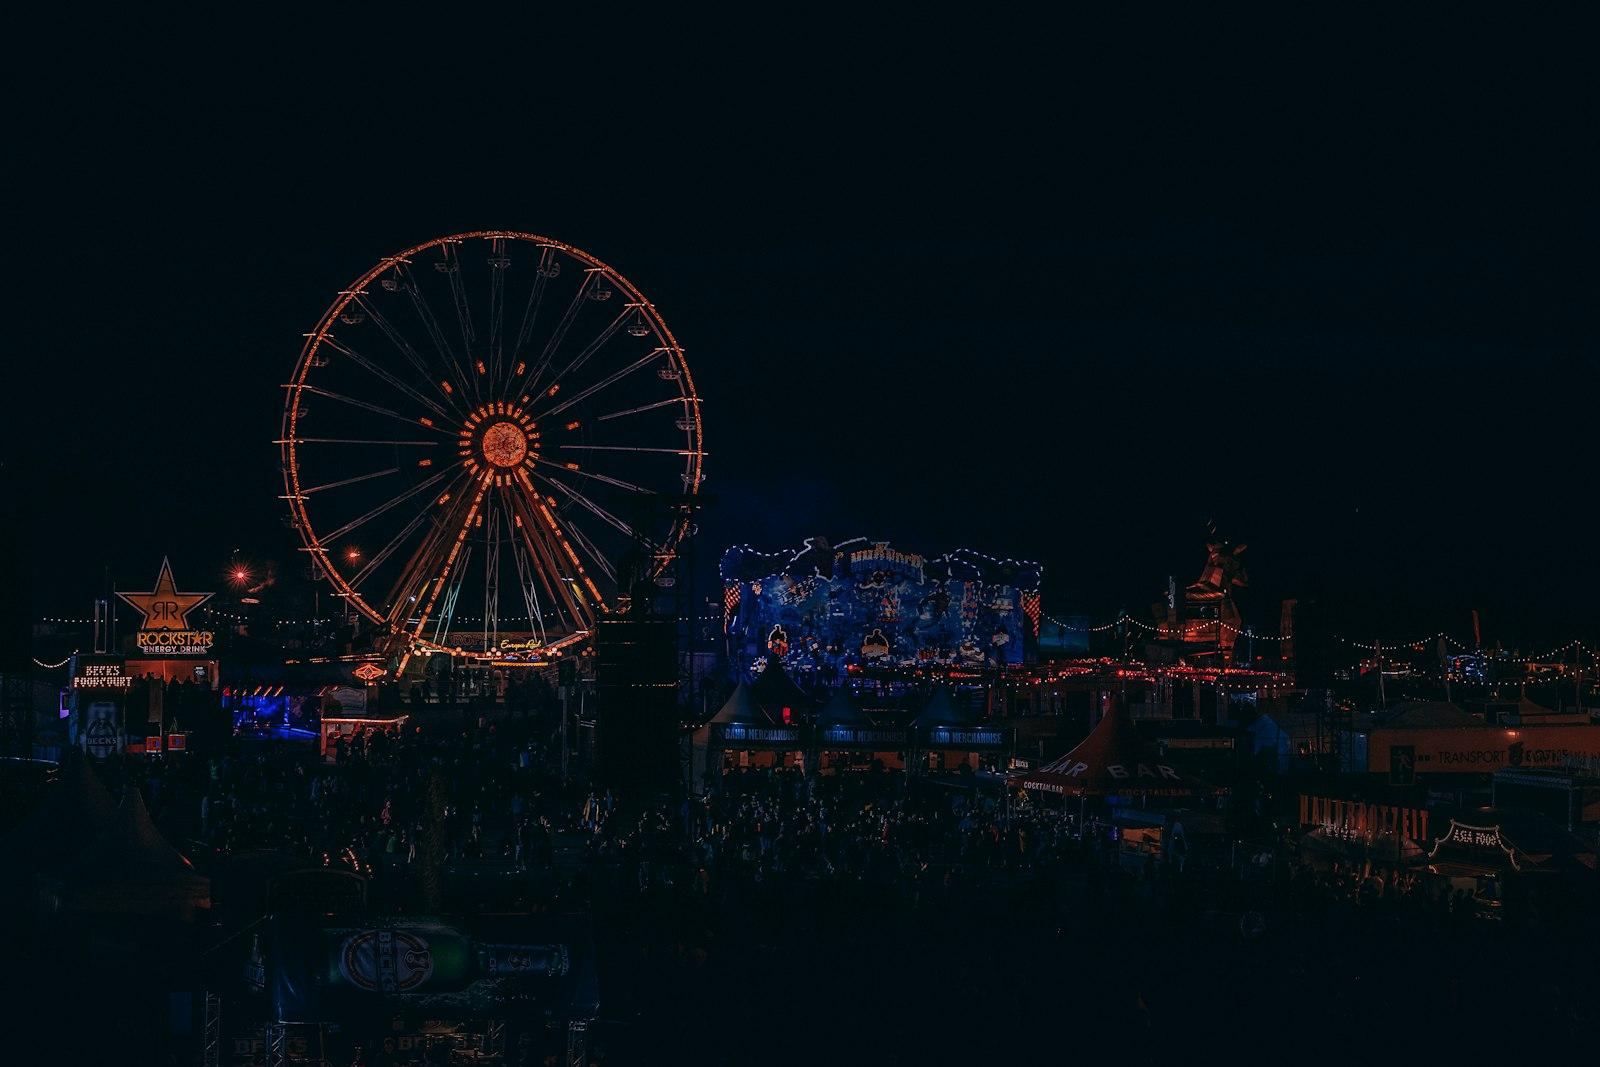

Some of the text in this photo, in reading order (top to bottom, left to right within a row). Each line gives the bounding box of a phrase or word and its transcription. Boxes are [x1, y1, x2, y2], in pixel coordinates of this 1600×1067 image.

[143, 645, 206, 654] ENERGY DRINK
[73, 677, 133, 688] FOODCOURT
[725, 729, 800, 742] BAND MERCHANDISE
[952, 731, 1002, 744] MERCHANDISE
[1438, 750, 1506, 764] TRANSPORT
[1106, 763, 1184, 781] BAR
[1475, 832, 1497, 846] FOOD
